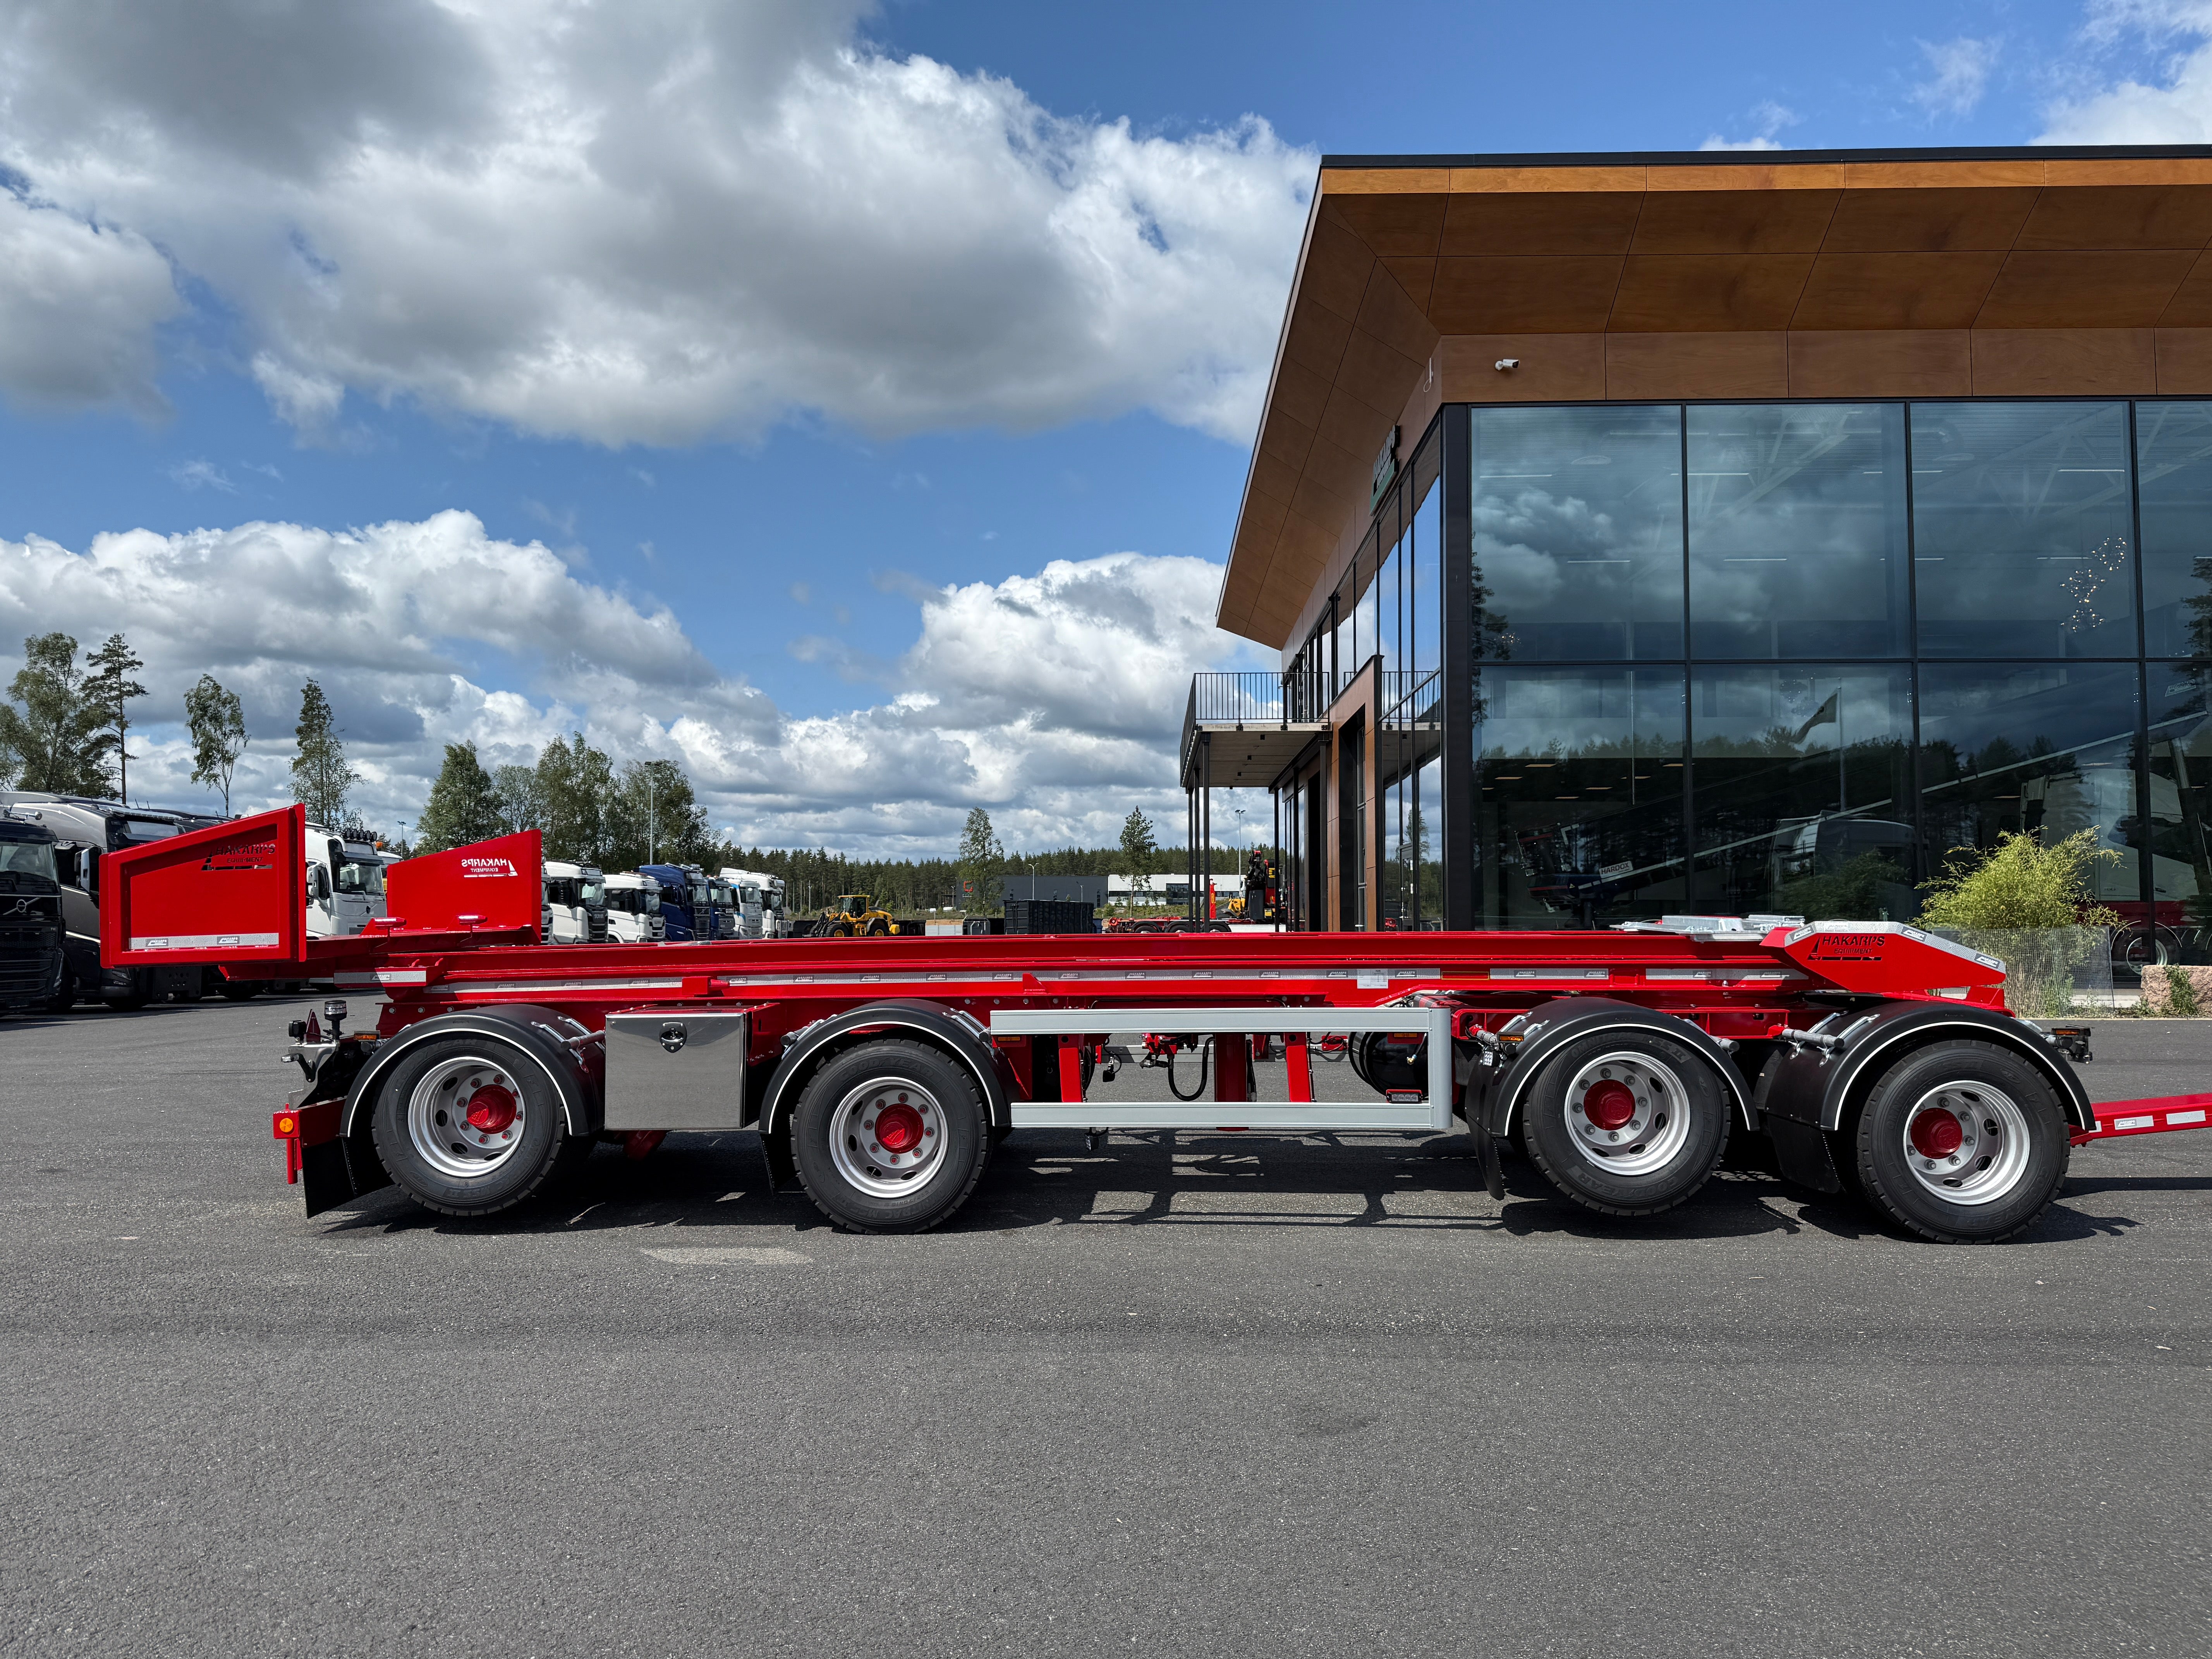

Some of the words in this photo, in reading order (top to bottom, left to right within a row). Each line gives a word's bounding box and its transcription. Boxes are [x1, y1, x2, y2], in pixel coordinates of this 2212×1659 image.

[215, 843, 276, 855] HAKARPS
[1601, 862, 1629, 874] HARDOX
[1822, 935, 1885, 947] HAKARPS
[840, 1056, 934, 1081] GOODYEAR
